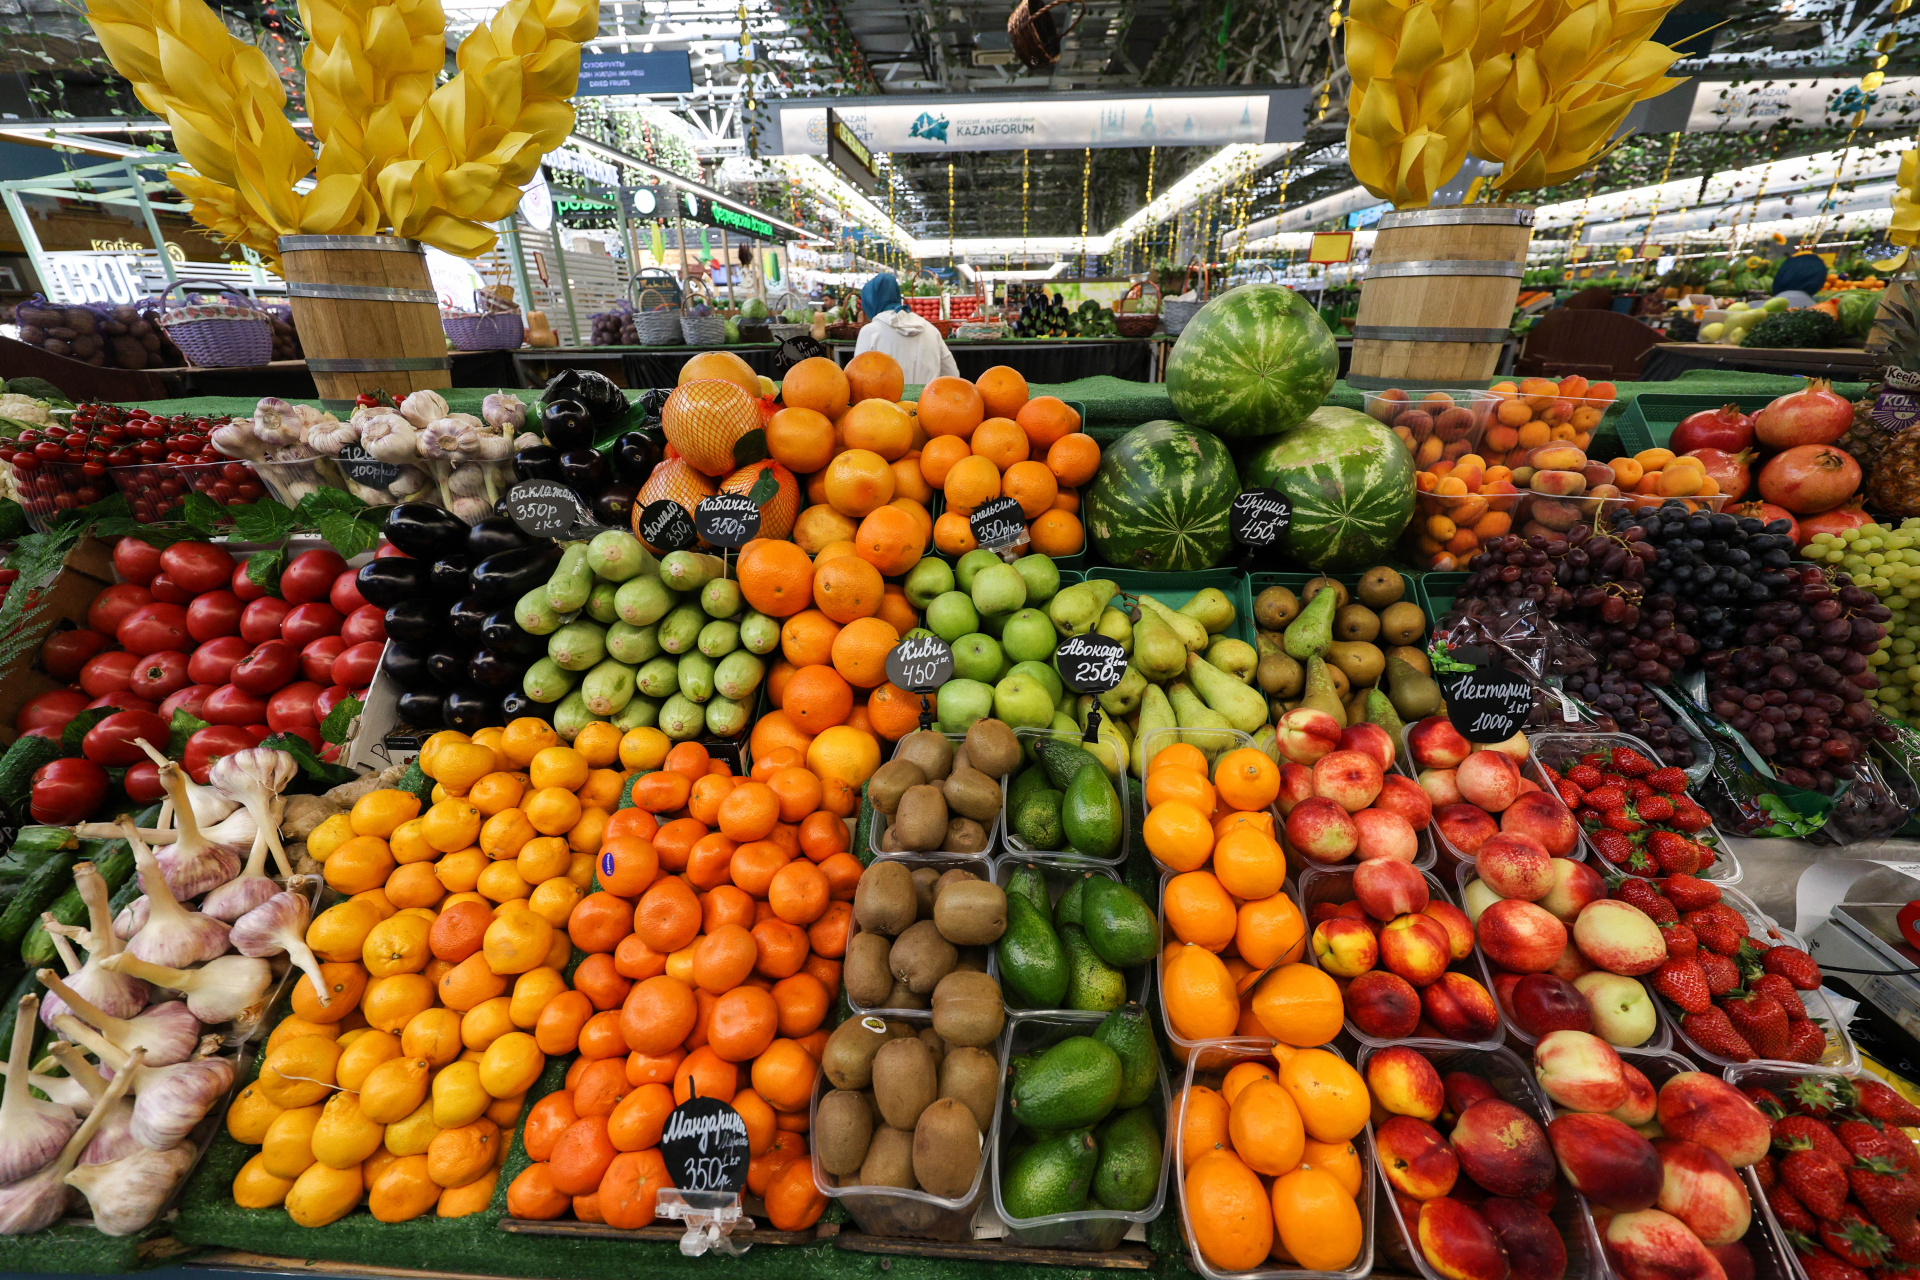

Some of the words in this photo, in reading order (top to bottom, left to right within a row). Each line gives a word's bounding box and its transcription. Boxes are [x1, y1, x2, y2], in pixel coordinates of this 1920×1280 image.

[957, 123, 1035, 136] KAZANFORUM
[516, 502, 557, 520] 350р
[698, 494, 759, 513] Кабачки
[970, 498, 1018, 524] апельсин
[1234, 491, 1291, 519] Груша
[643, 501, 679, 543] Помело
[666, 520, 693, 547] 350р
[707, 516, 746, 542] 350р
[897, 636, 947, 662] Киви
[1057, 638, 1125, 667] Авокадо
[902, 661, 937, 687] 450
[1450, 674, 1531, 705] Нектарин
[1469, 711, 1513, 736] 1000р
